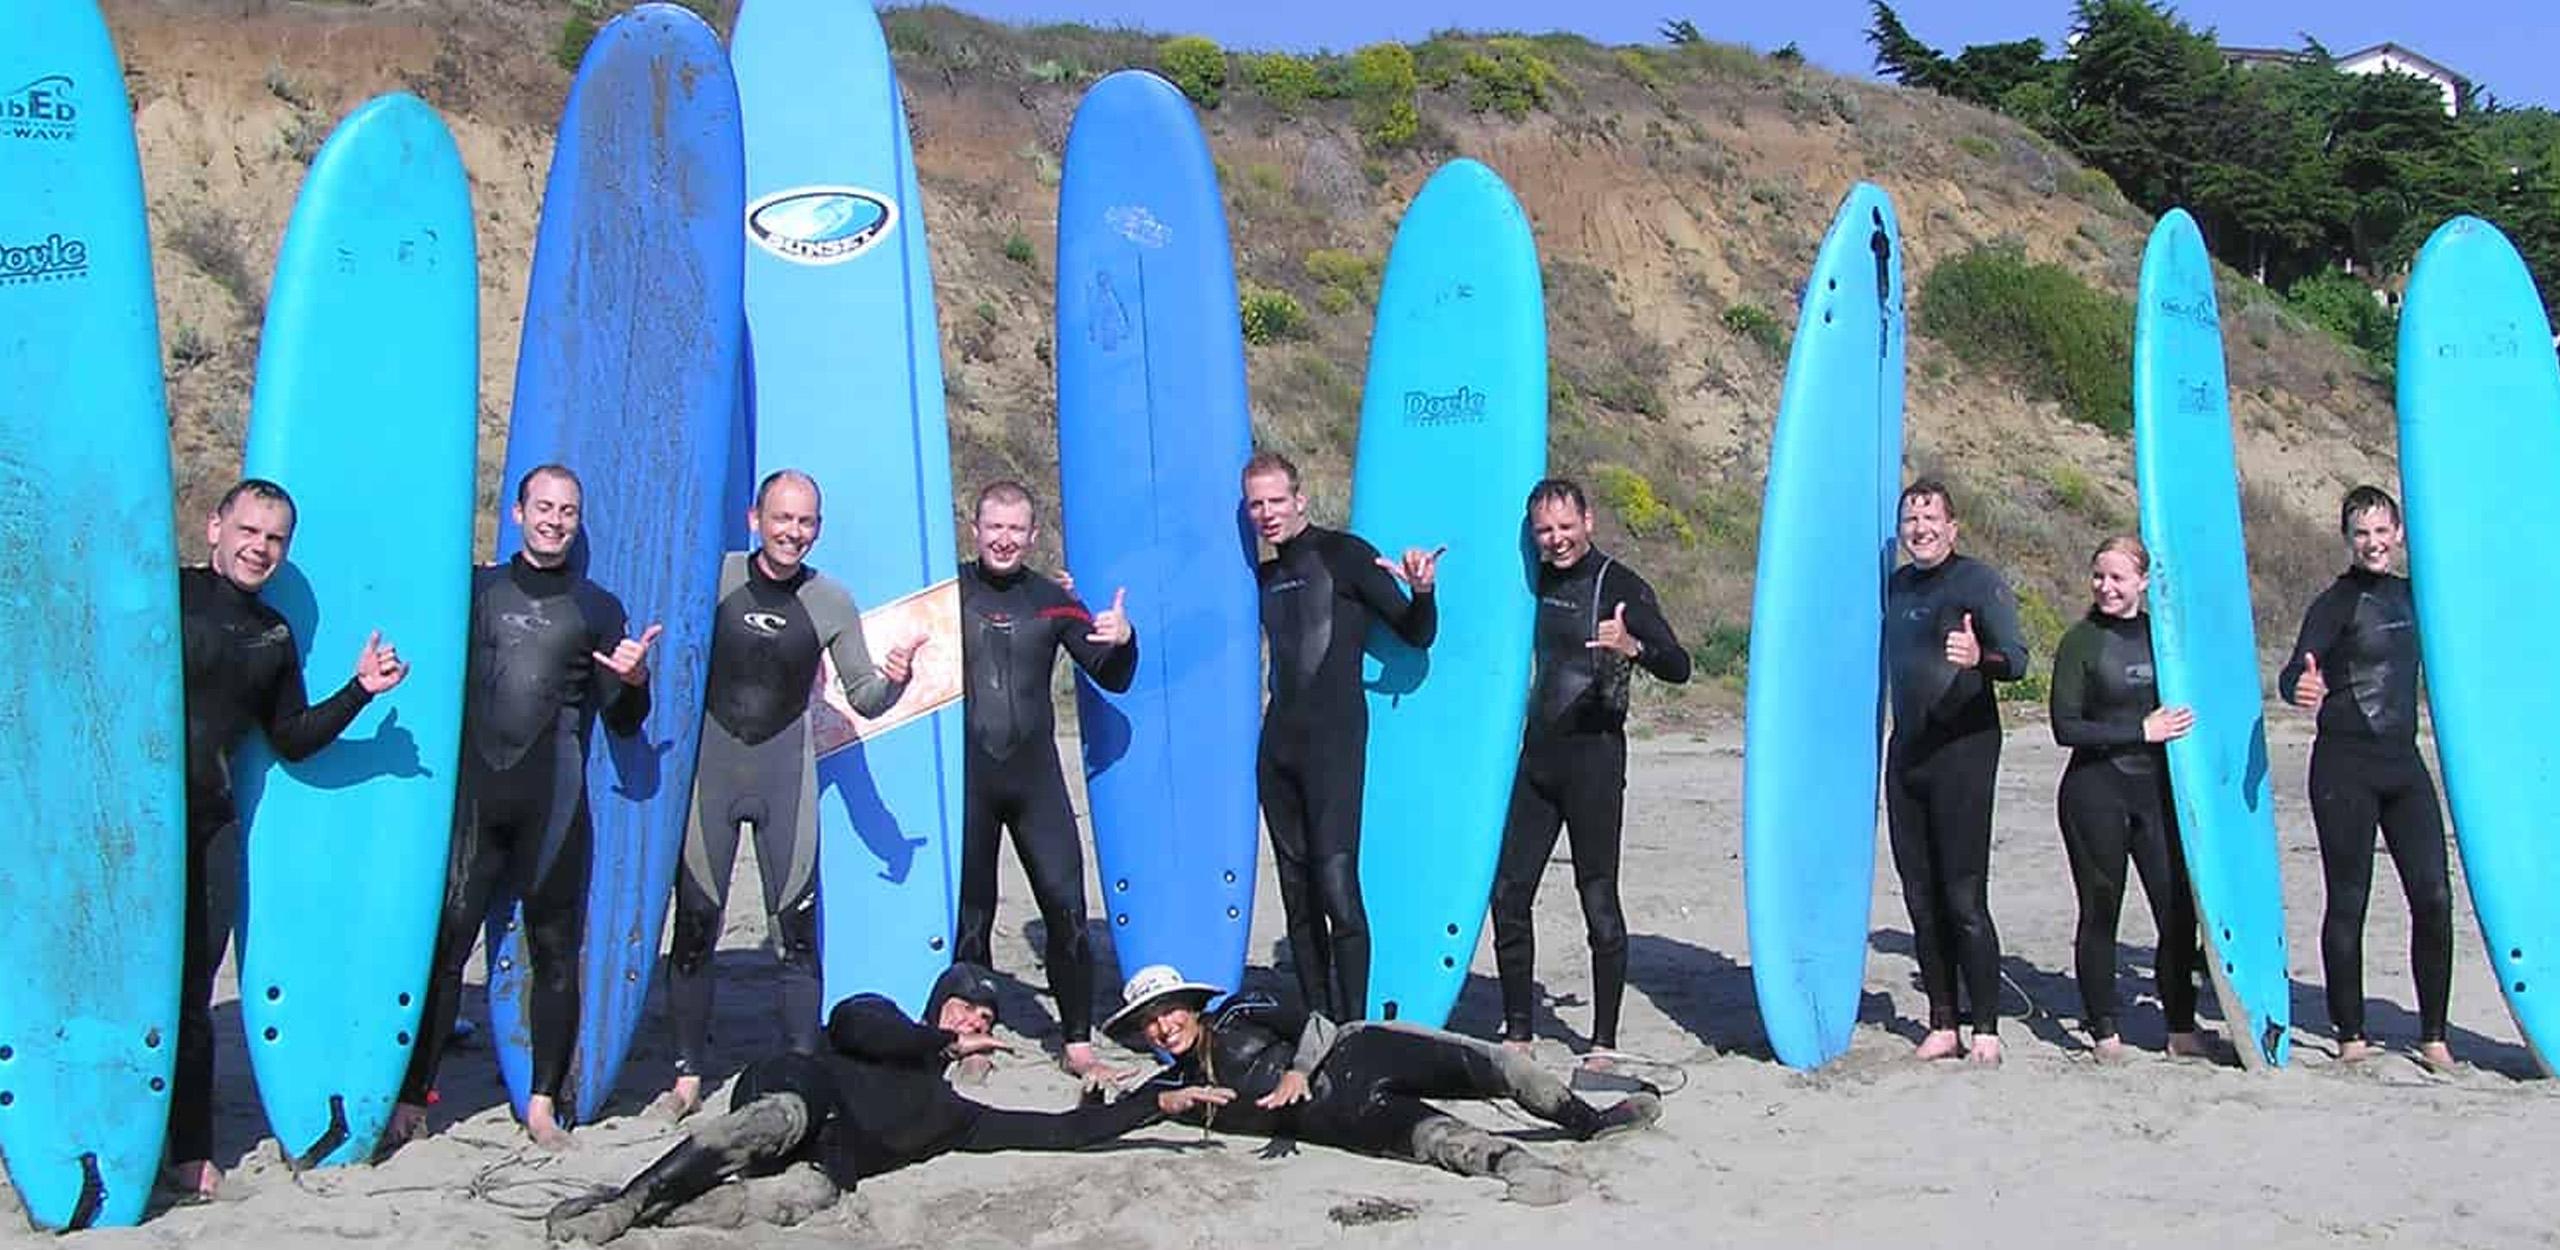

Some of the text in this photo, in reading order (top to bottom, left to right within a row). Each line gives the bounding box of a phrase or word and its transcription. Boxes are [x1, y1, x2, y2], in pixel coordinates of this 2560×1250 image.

[0, 89, 76, 121] bED
[0, 127, 74, 140] -WAVE
[766, 226, 876, 258] SUNSET
